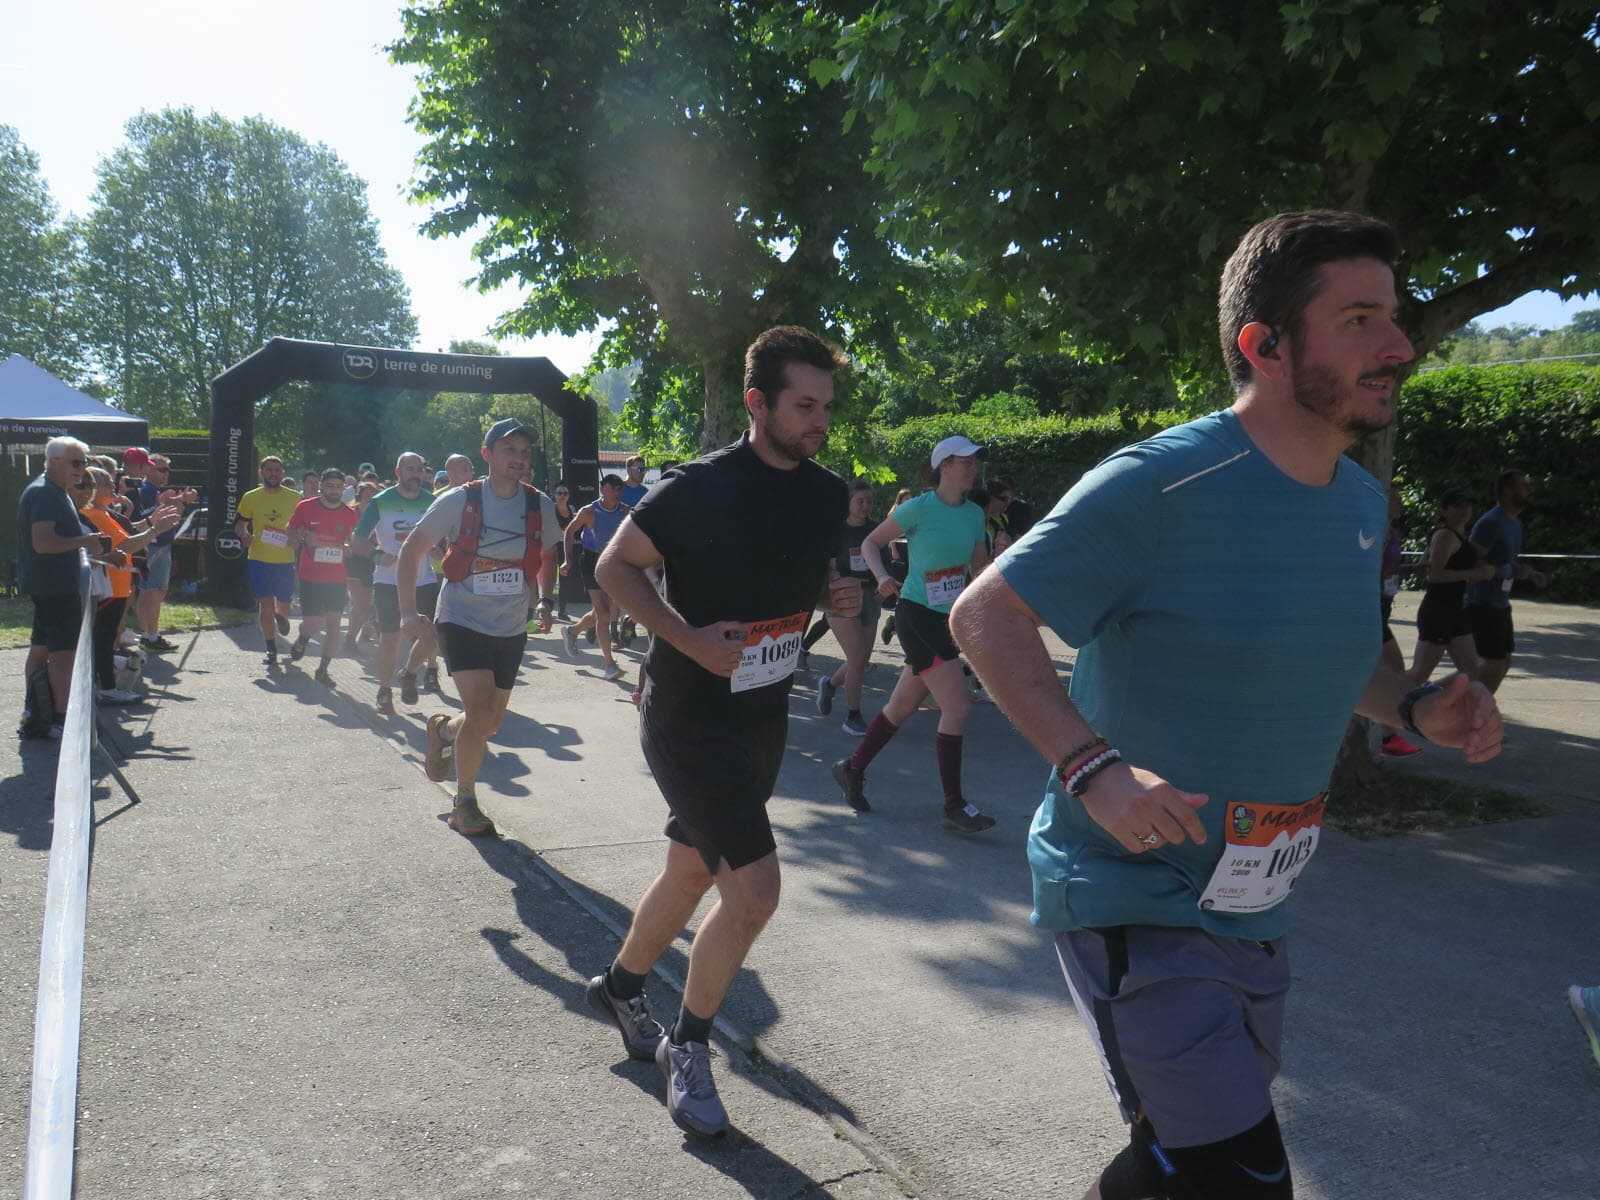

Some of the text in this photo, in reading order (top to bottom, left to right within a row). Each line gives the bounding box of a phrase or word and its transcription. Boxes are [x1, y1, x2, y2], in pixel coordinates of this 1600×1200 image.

[346, 355, 374, 369] TDR
[384, 358, 493, 380] terre de running
[12, 423, 25, 433] de
[27, 424, 68, 435] running
[226, 428, 242, 474] running
[225, 477, 237, 493] de
[760, 636, 799, 665] 1089
